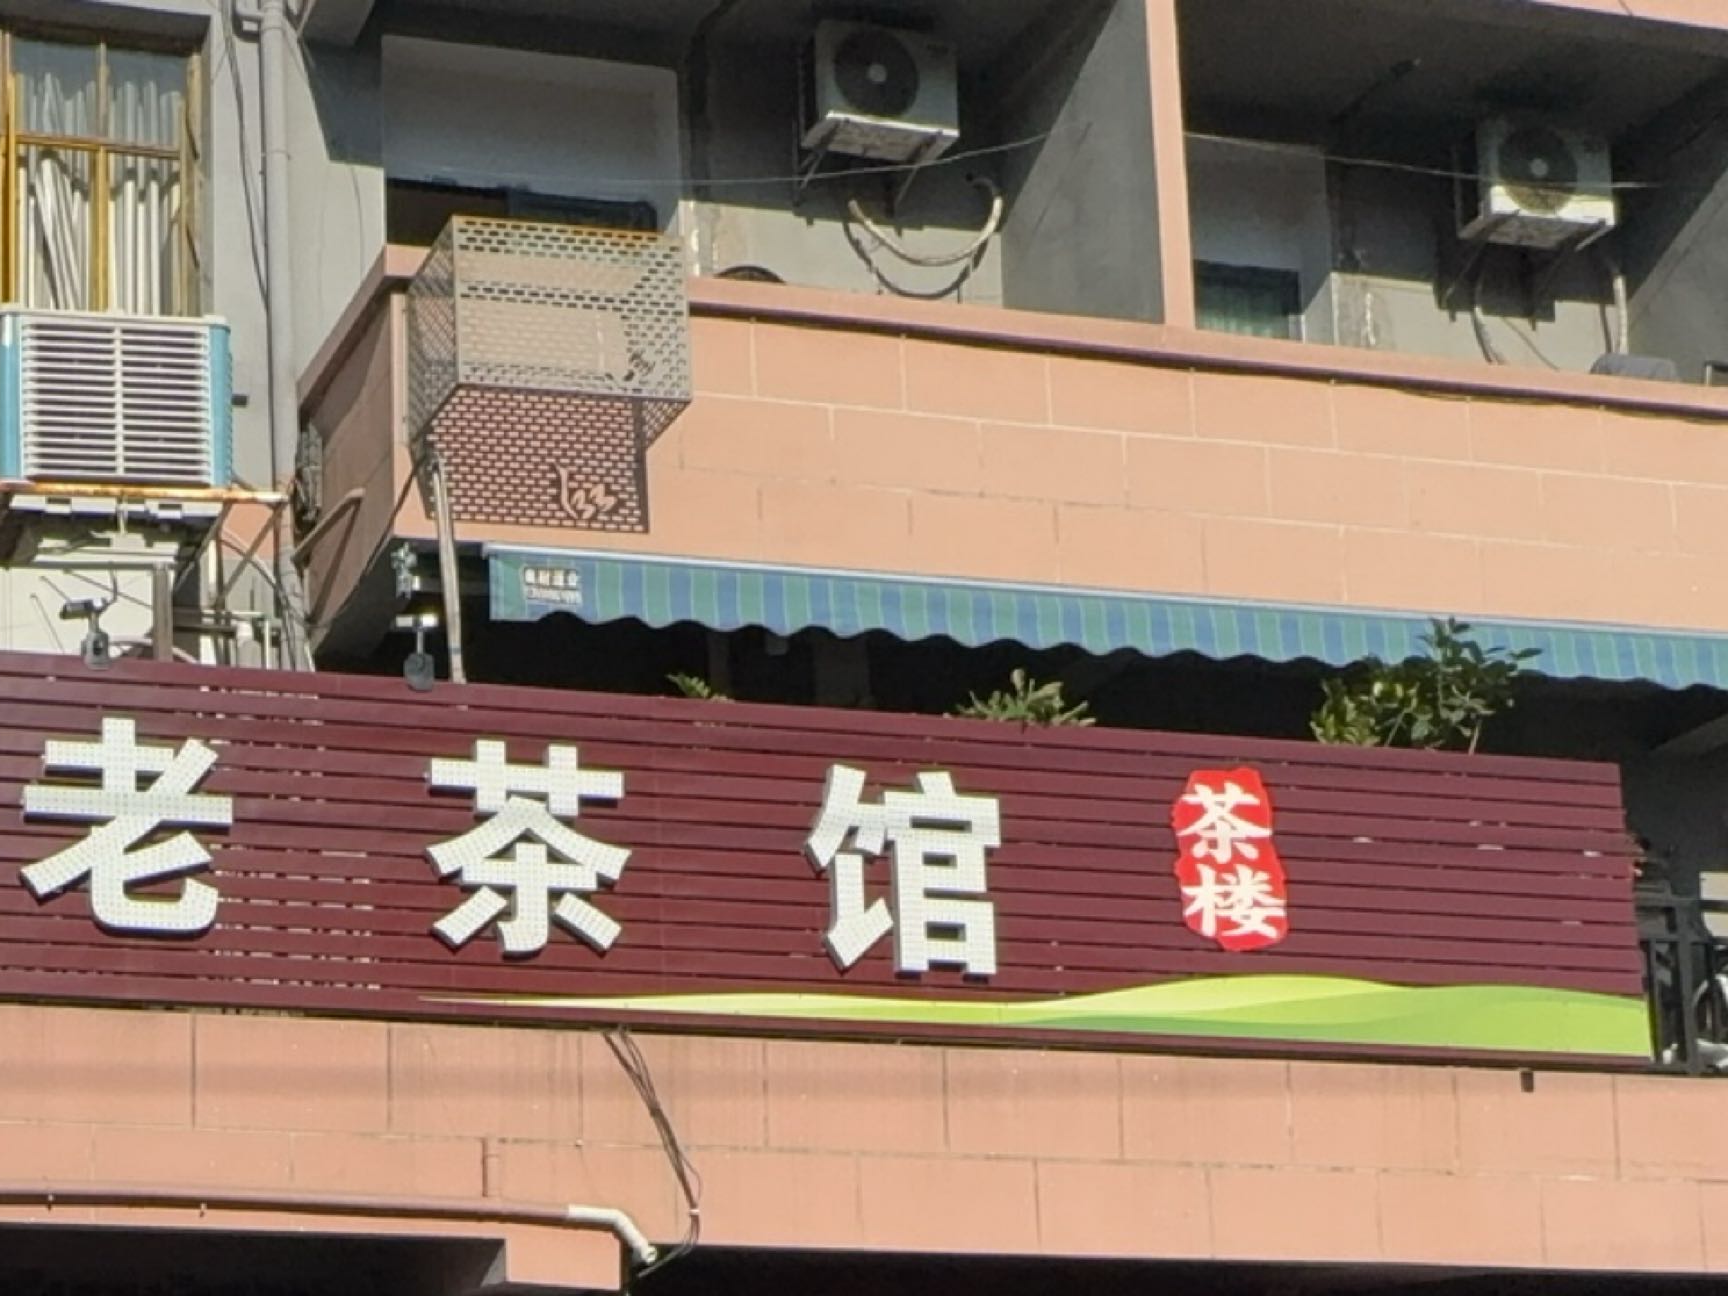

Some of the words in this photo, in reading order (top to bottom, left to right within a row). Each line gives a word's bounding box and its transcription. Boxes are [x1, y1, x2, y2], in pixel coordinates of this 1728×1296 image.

[20, 717, 1002, 978] 老茶馆
[1176, 782, 1288, 938] 茶楼
